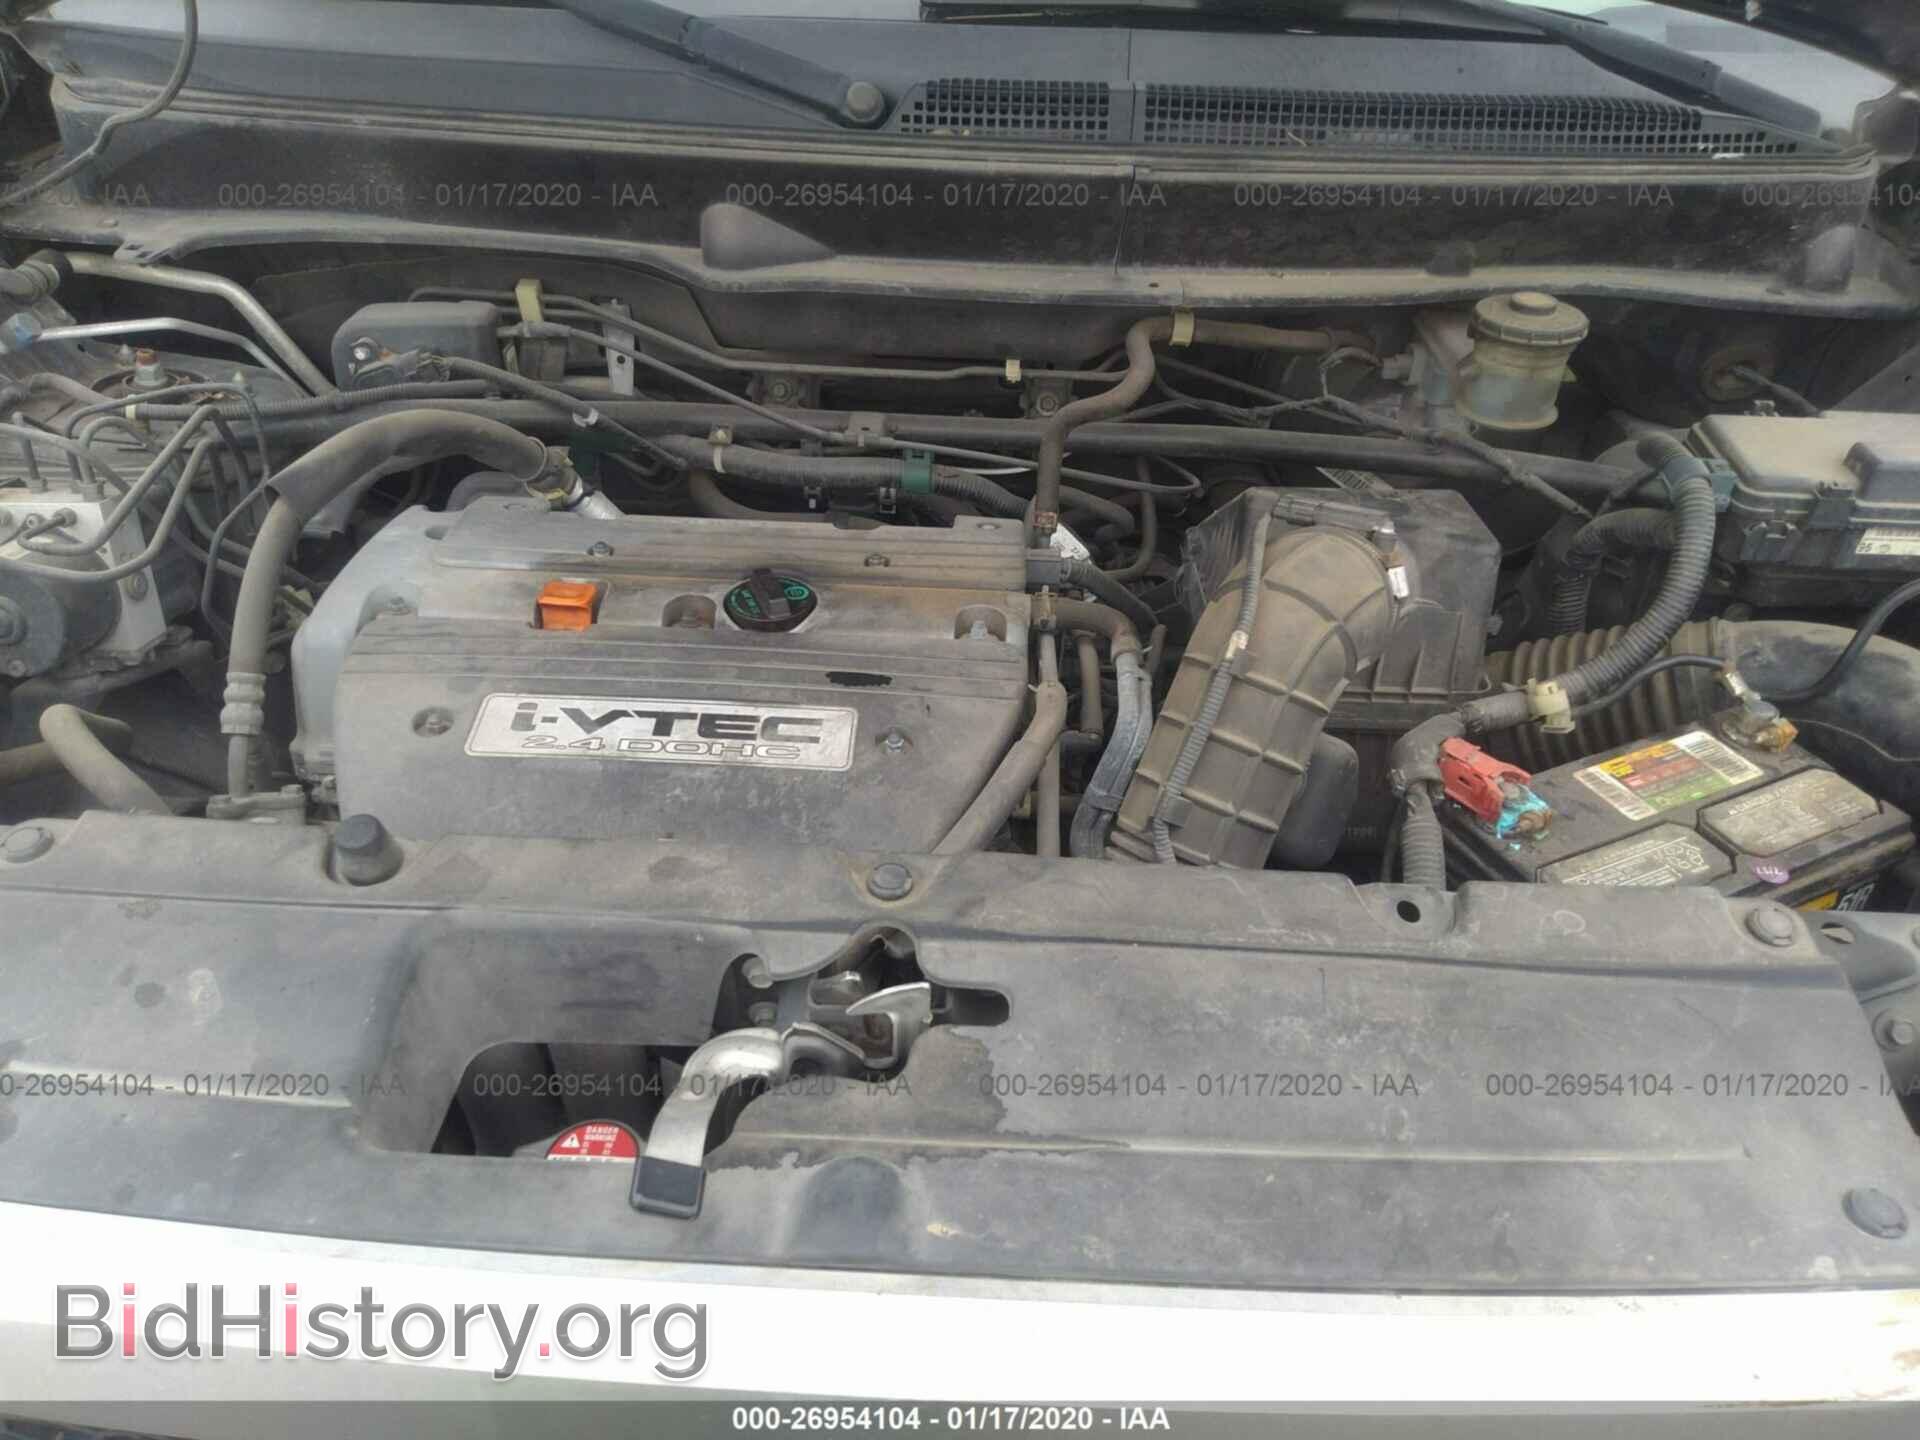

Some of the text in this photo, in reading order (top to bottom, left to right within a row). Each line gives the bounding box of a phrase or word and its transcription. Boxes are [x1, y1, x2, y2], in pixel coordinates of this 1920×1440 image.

[510, 702, 824, 744] i-VTEC
[520, 735, 801, 759] 2.4 DOHC
